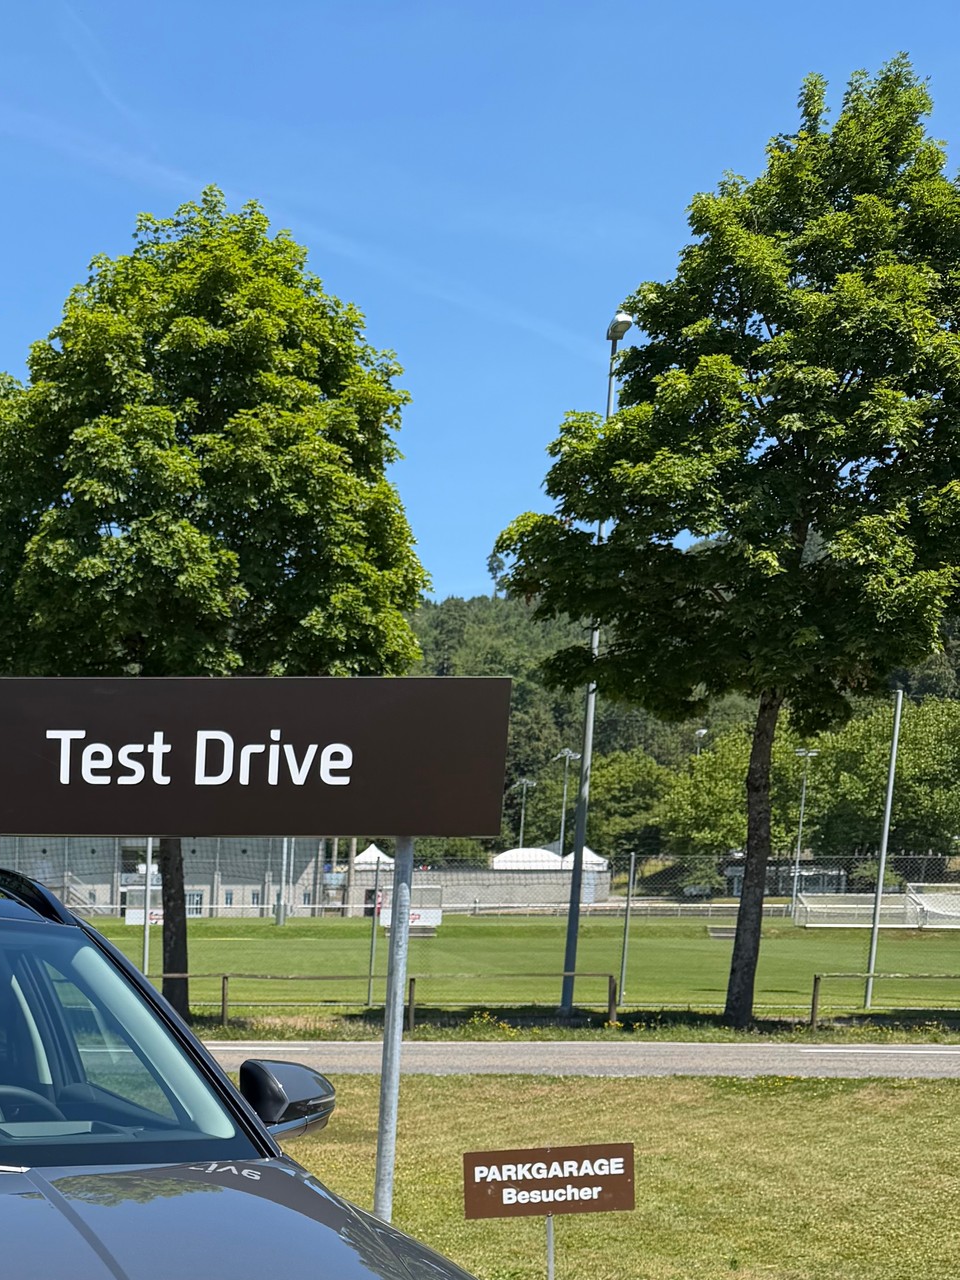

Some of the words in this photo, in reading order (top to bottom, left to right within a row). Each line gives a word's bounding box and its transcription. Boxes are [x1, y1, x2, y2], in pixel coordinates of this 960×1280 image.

[46, 729, 171, 785] Test
[195, 729, 353, 785] Drive
[474, 1158, 625, 1183] PARKGARAGE
[502, 1185, 602, 1205] Besucher
